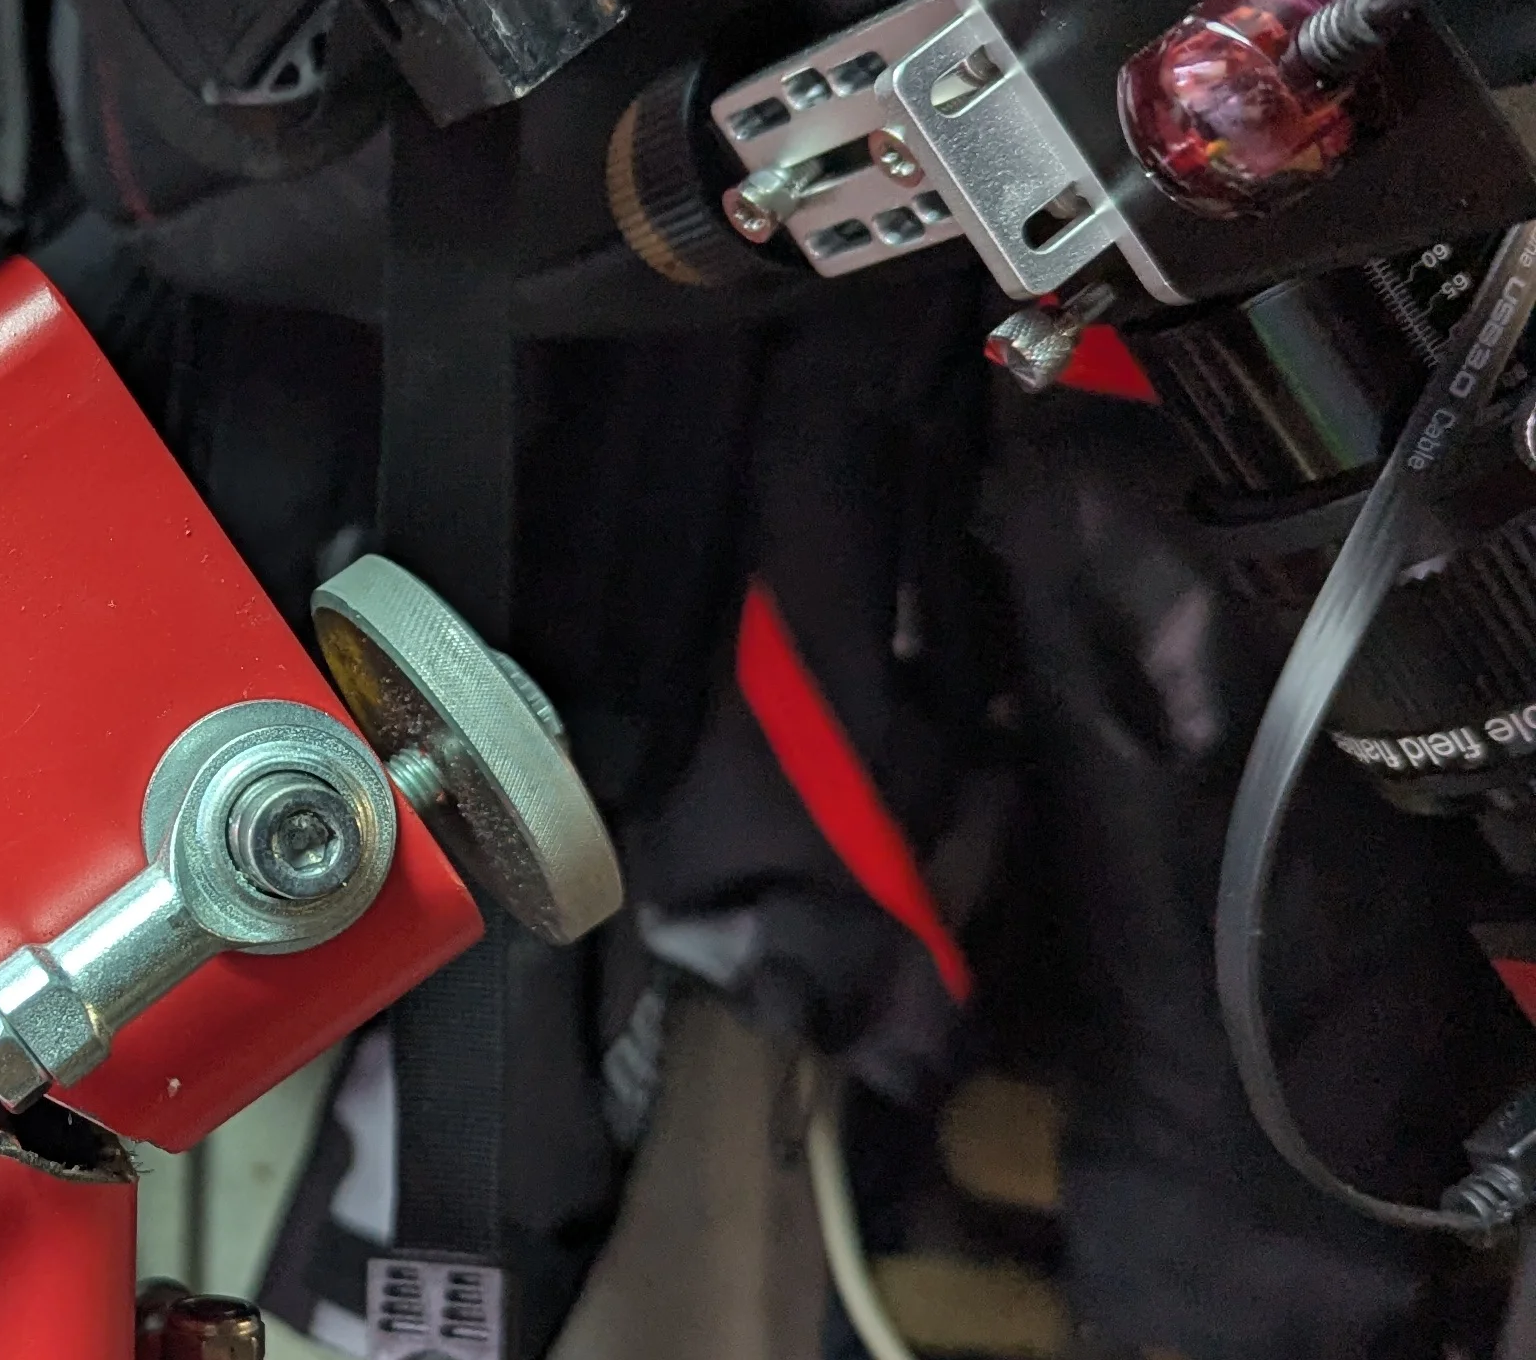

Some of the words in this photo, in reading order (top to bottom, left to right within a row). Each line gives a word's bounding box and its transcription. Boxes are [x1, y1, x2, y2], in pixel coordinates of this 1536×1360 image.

[1420, 243, 1452, 269] 60
[1440, 272, 1471, 300] 65
[1407, 408, 1457, 471] Cable
[1395, 727, 1484, 769] field
